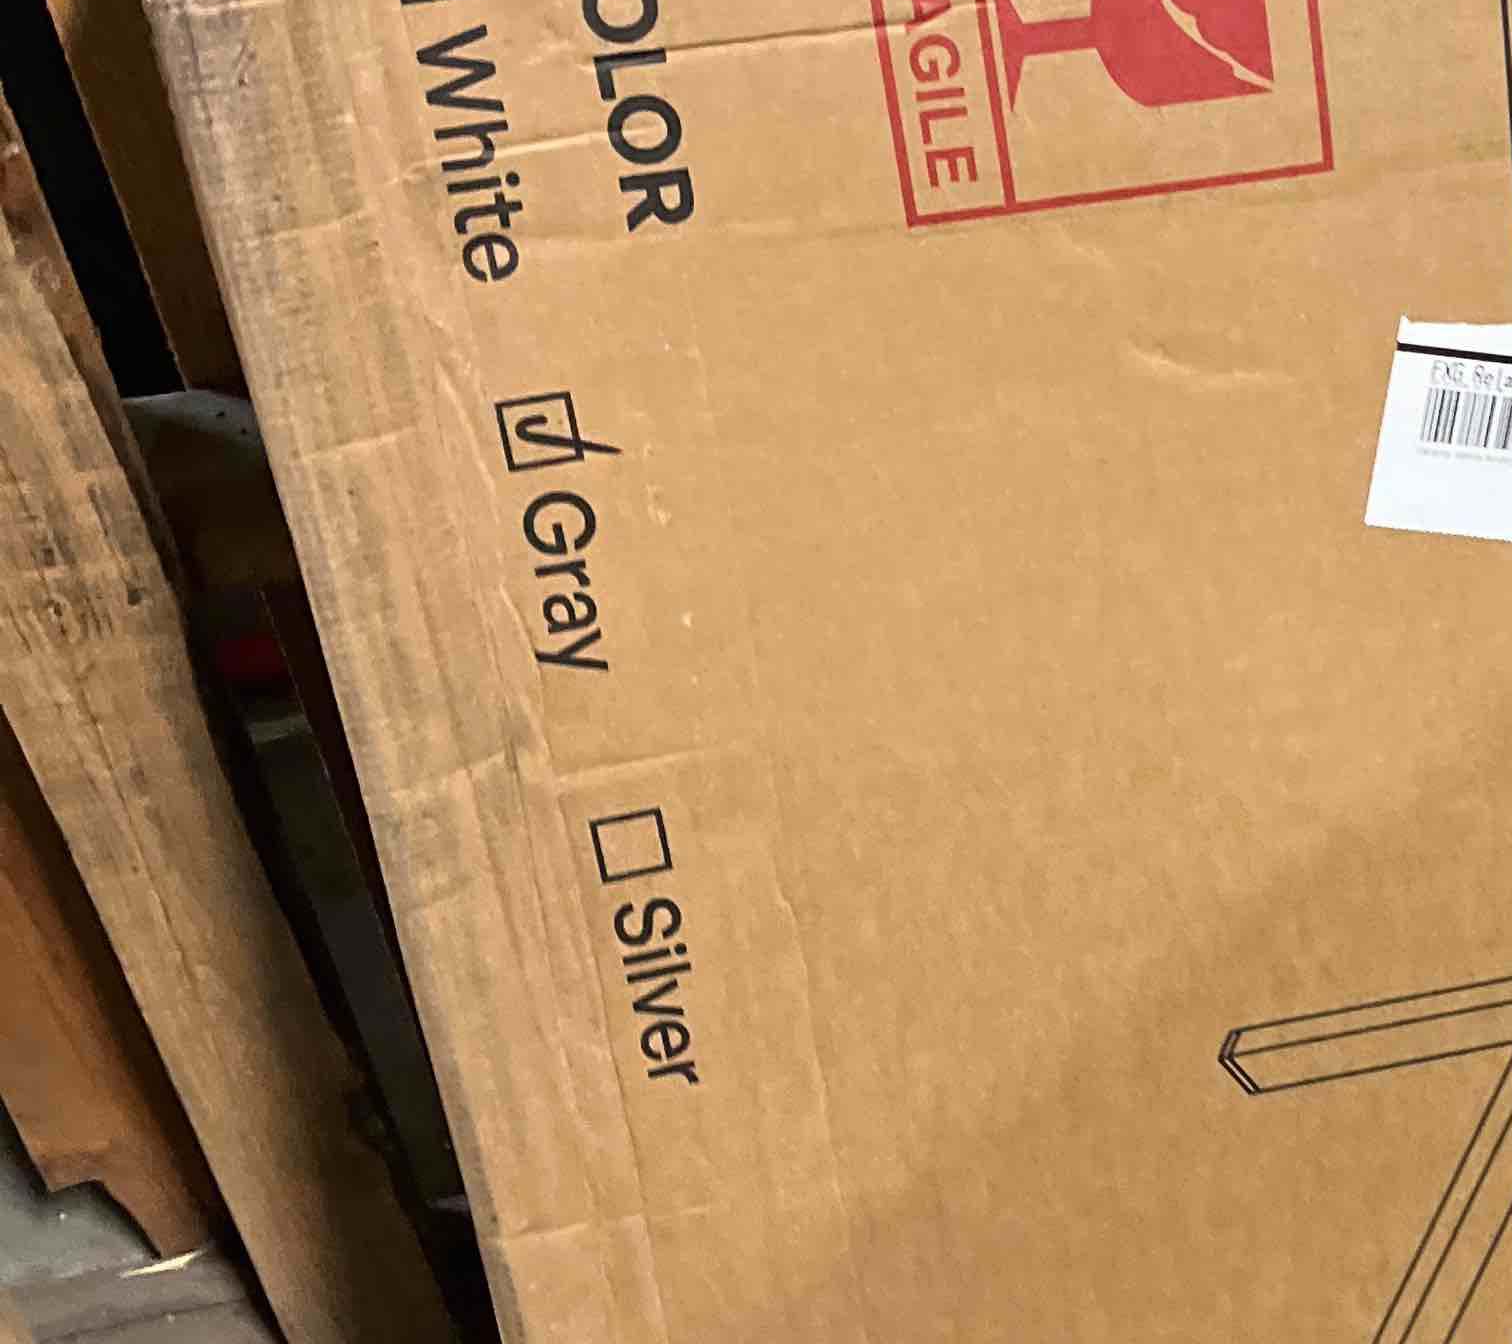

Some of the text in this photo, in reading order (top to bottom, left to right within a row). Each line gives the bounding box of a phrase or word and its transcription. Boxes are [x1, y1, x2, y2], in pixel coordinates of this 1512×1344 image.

[416, 24, 525, 284] White
[522, 490, 609, 672] Gray
[613, 897, 700, 1087] Silver
